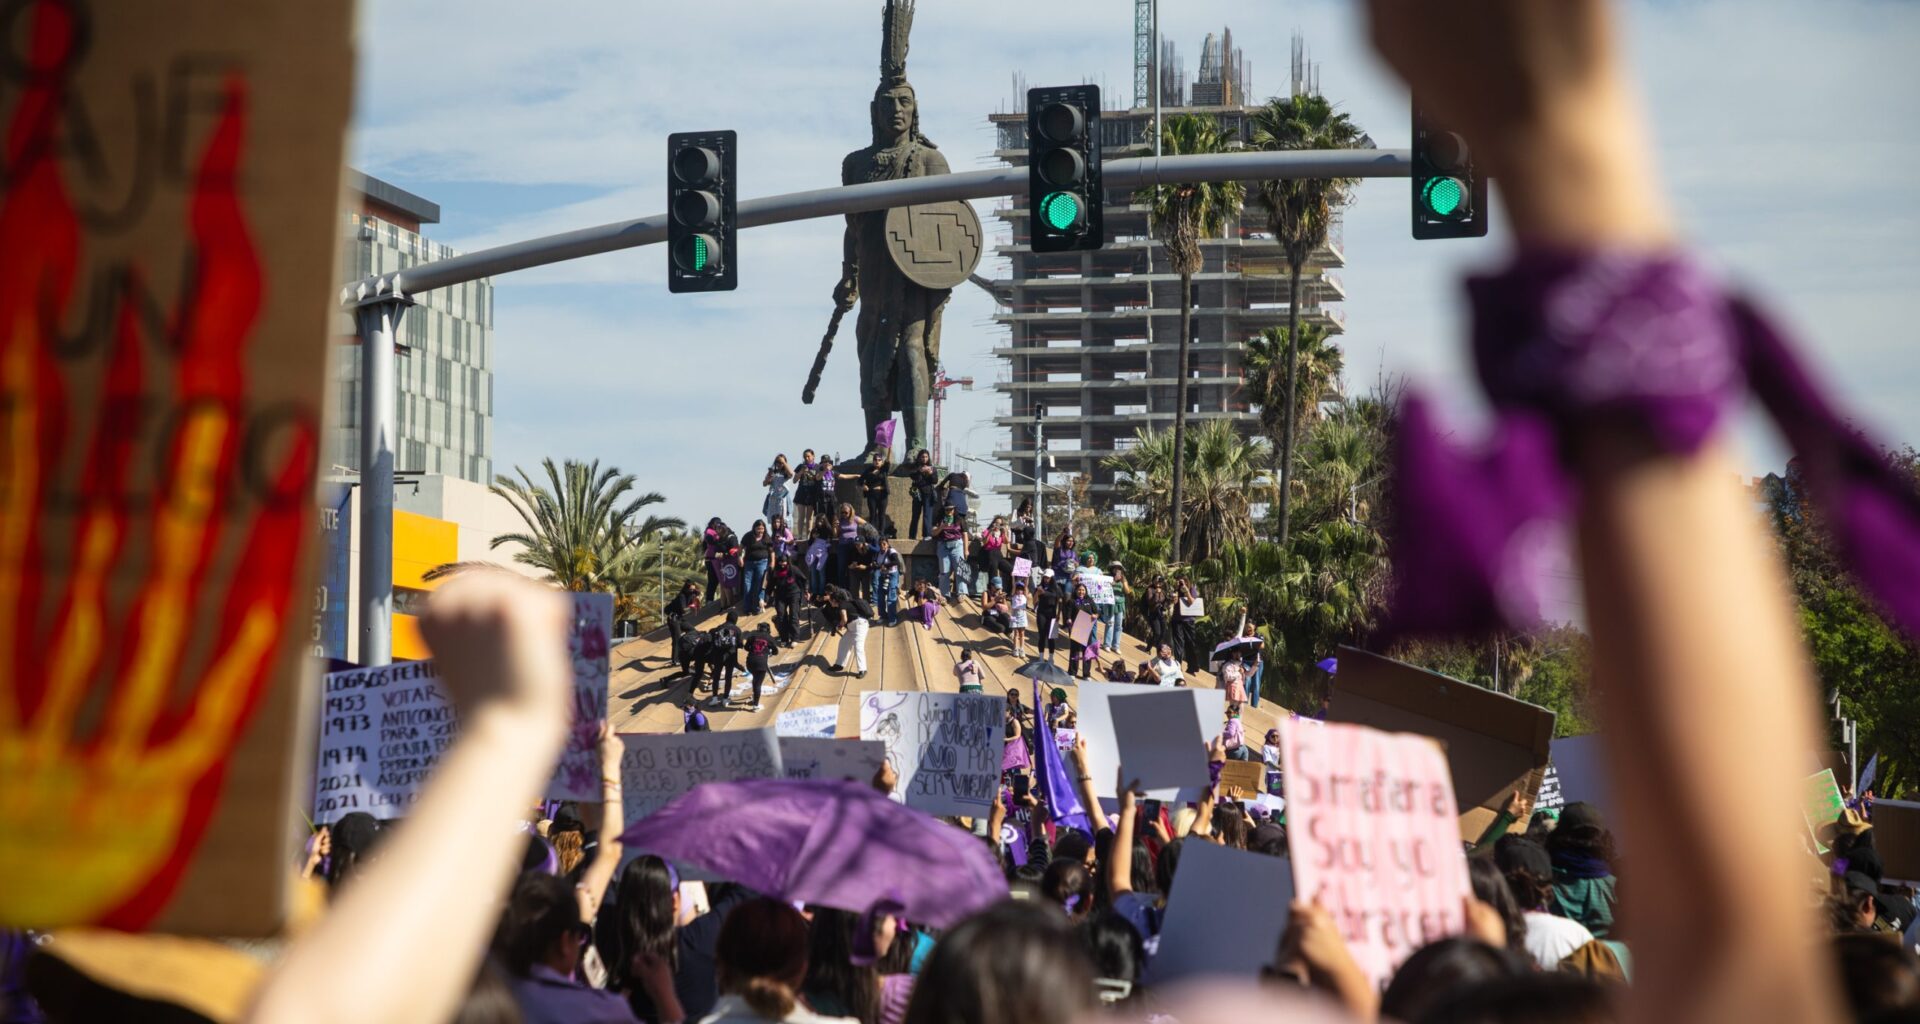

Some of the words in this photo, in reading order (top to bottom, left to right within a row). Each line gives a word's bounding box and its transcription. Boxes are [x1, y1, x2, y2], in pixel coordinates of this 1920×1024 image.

[326, 669, 390, 693] LOGROS
[326, 693, 367, 716] 1953
[381, 684, 447, 709] VOTAR
[953, 696, 1003, 728] MORIR
[325, 715, 371, 737] 1973
[381, 727, 419, 743] PARA
[378, 740, 430, 760] CUENTA
[967, 745, 996, 778] POR
[319, 774, 362, 793] 2021
[915, 773, 946, 796] SER
[318, 794, 359, 812] 2021
